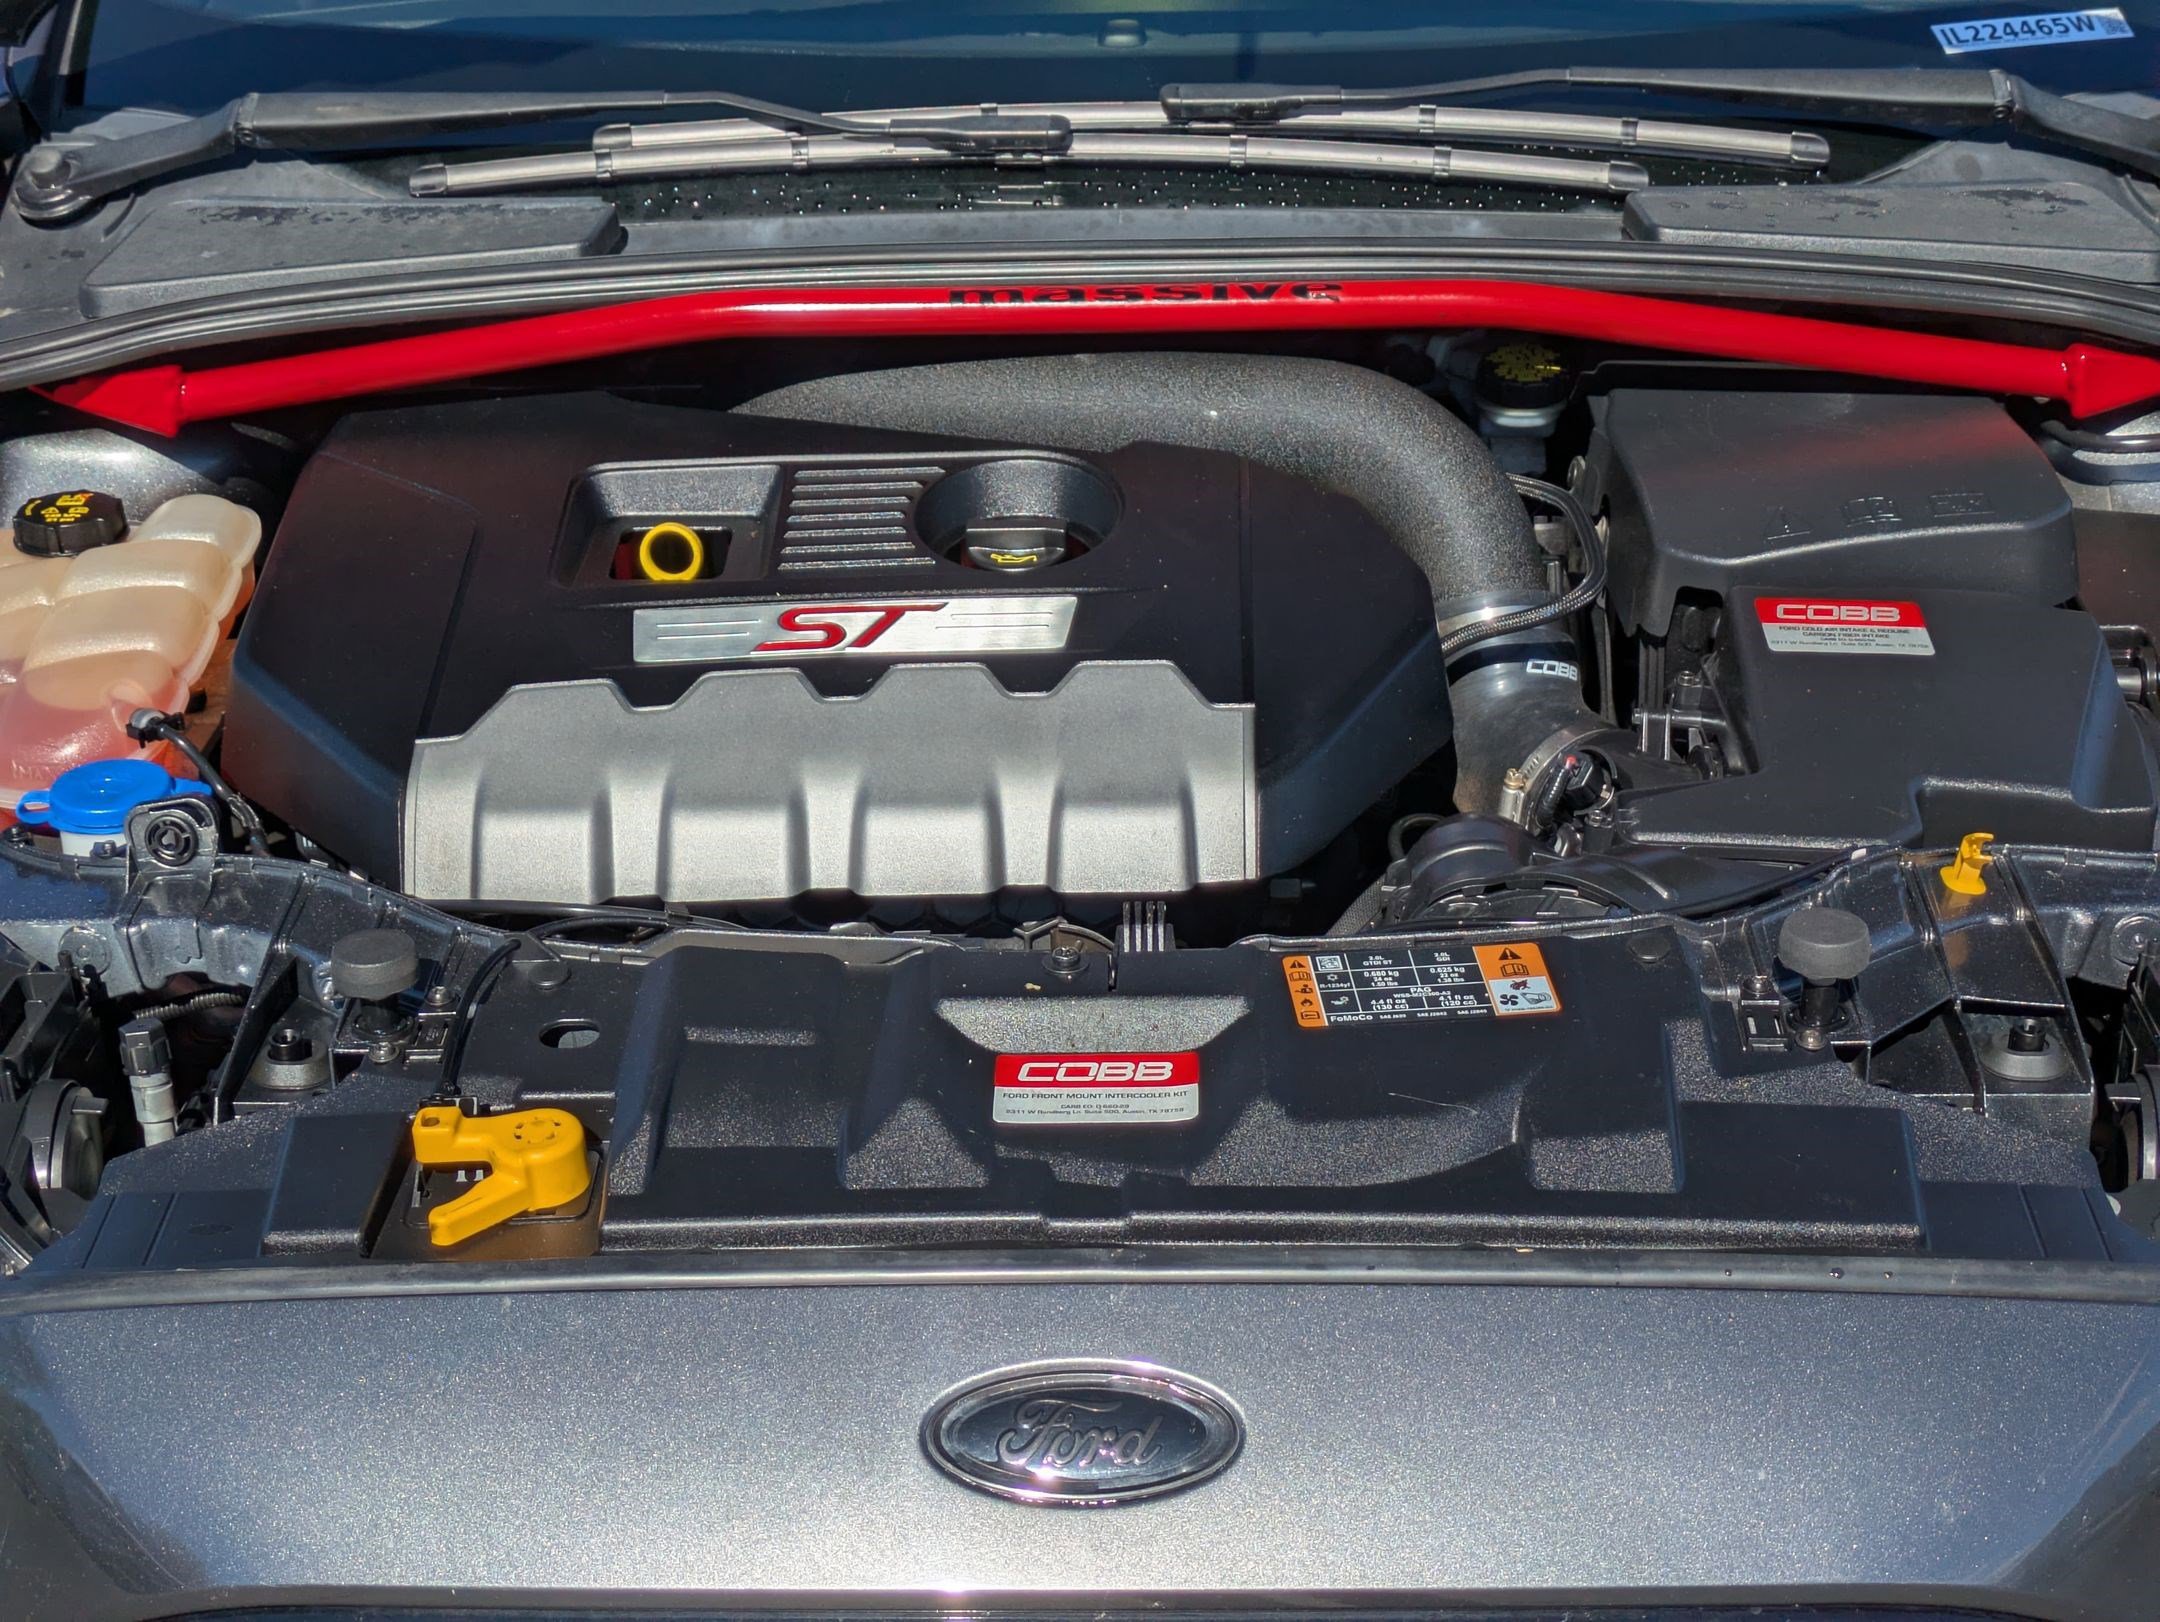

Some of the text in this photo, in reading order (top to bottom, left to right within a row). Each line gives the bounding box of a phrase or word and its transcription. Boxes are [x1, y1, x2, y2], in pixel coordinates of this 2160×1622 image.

[948, 283, 1343, 304] massive
[1777, 604, 1900, 622] COBB
[752, 602, 949, 652] ST
[1526, 659, 1577, 681] COBB
[1018, 1062, 1173, 1081] COBB
[998, 1399, 1165, 1467] Ford
